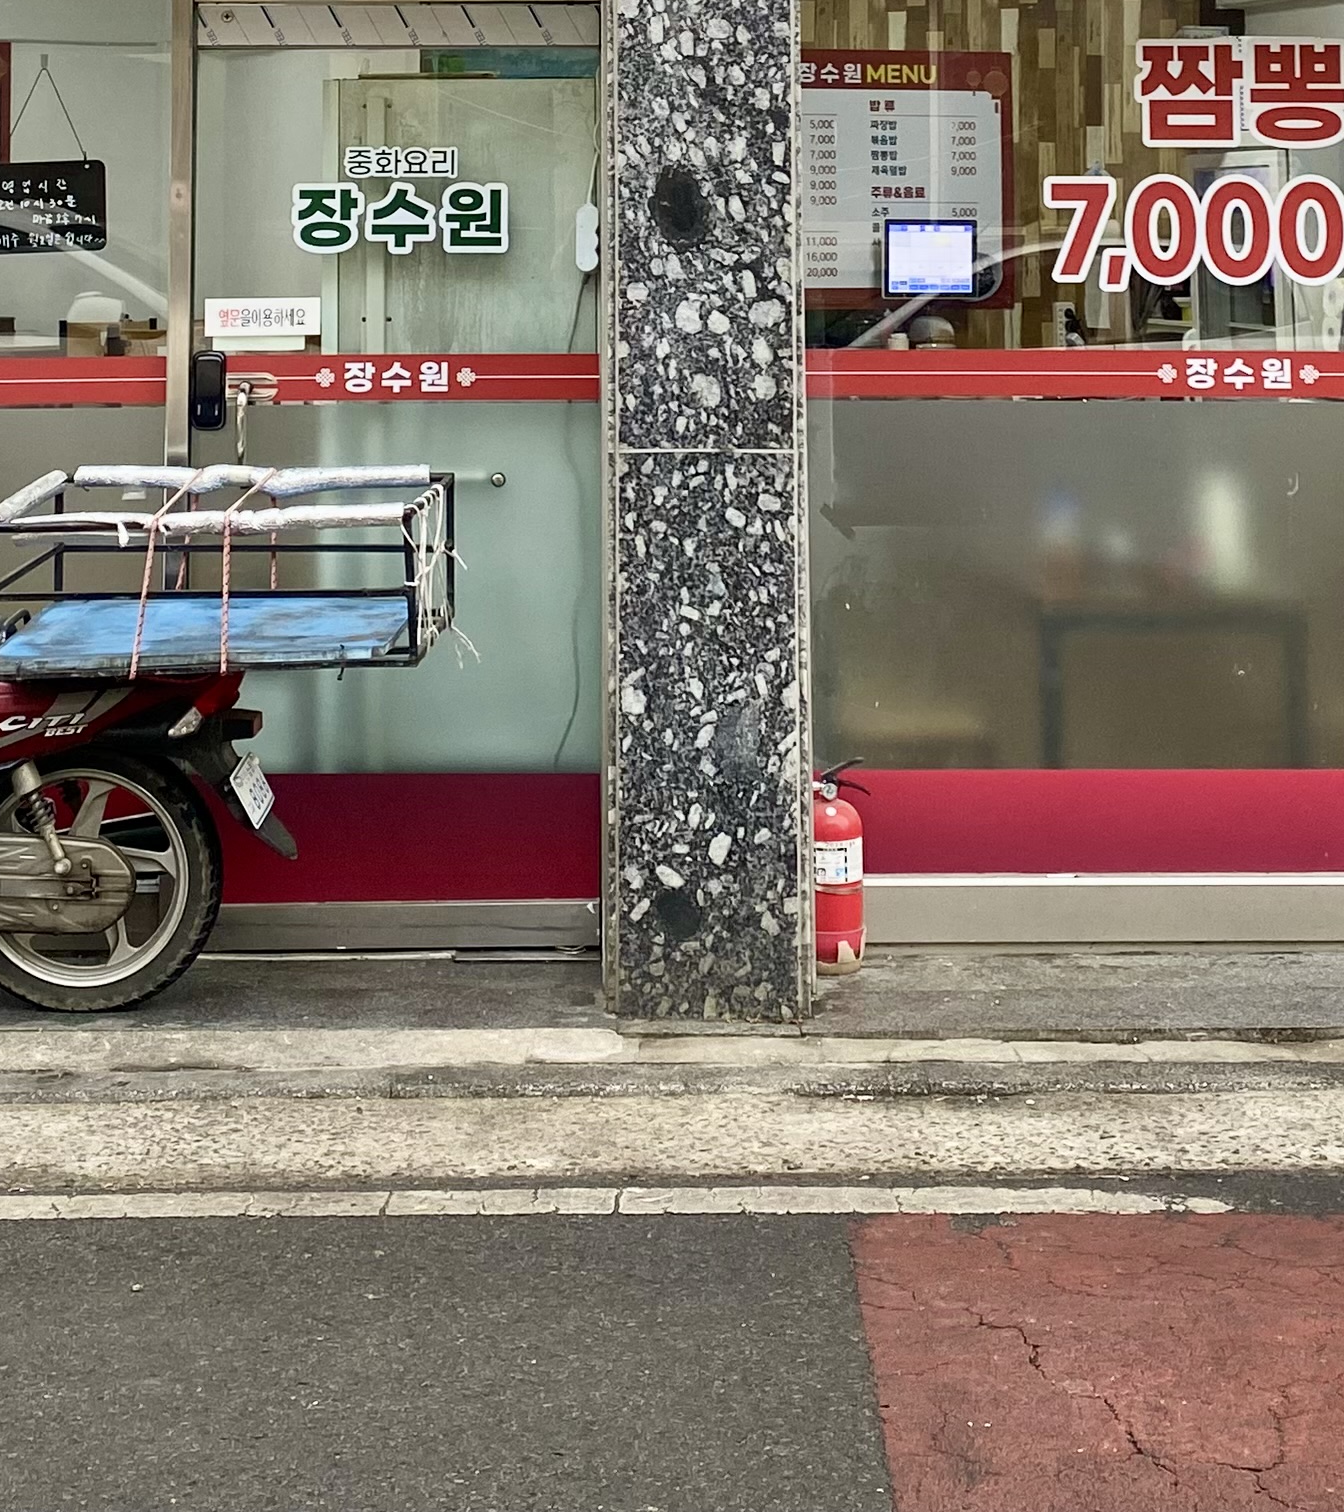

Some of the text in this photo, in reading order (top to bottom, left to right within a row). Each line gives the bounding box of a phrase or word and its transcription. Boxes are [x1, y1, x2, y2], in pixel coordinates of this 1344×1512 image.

[800, 63, 938, 84] 장수원 MENU
[809, 120, 835, 130] 5,000
[810, 135, 836, 144] 7,000
[951, 136, 976, 146] 7,000
[810, 150, 836, 160] 7,000
[951, 152, 976, 162] 7,000
[346, 148, 458, 176] 중화요리
[810, 165, 836, 175] 9,000
[951, 166, 977, 176] 9,000
[810, 180, 837, 190] 9,000
[811, 196, 838, 206] 9,000
[296, 187, 504, 249] 장수원
[872, 208, 978, 218] 소주 5,000
[806, 236, 838, 247] 11,000
[806, 252, 838, 262] 16,000
[806, 268, 838, 278] 20,000
[218, 308, 306, 328] 옆문을이용하세요
[343, 361, 450, 393] 장수원
[1185, 358, 1293, 391] 장수원
[44, 724, 88, 737] BEST
